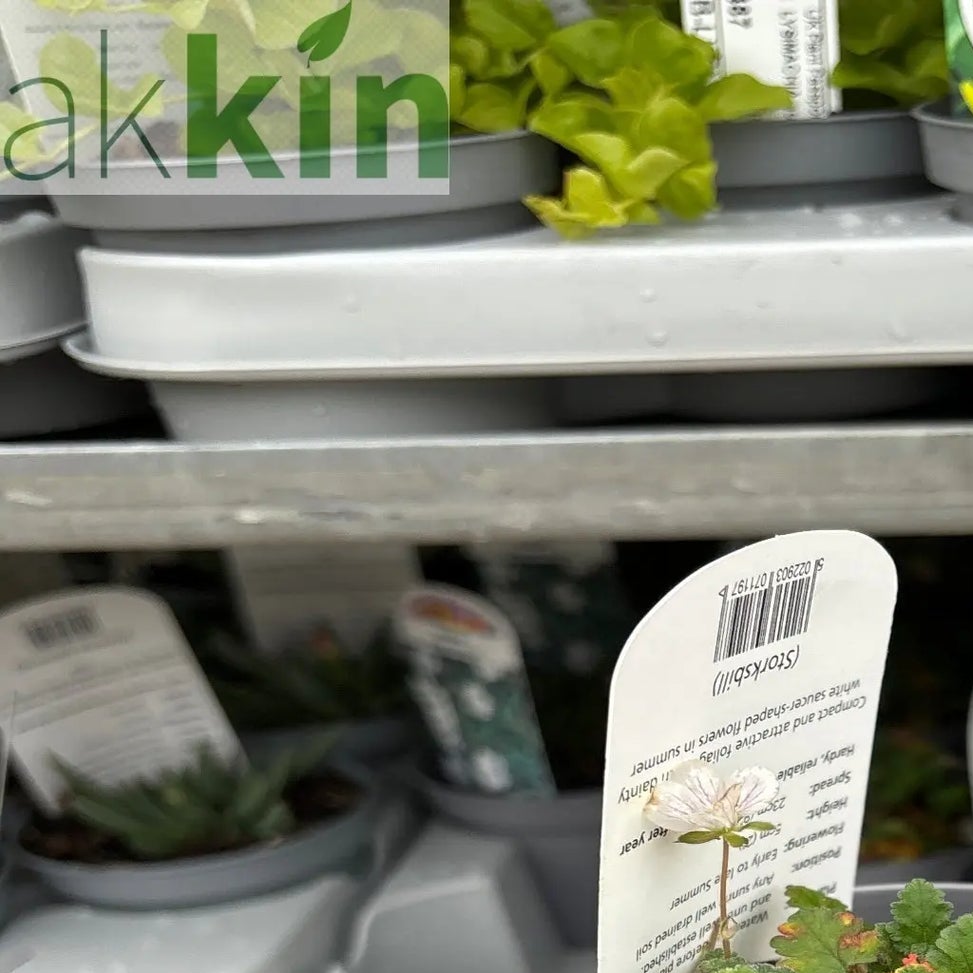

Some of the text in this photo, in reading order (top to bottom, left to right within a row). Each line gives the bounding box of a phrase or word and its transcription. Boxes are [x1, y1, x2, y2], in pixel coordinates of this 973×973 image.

[776, 560, 811, 583] 022903
[731, 572, 767, 597] 071197
[712, 644, 800, 697] (Storksbill)
[828, 679, 861, 698] white
[744, 689, 826, 731] saucer-shaped
[699, 721, 741, 748] flowers
[617, 696, 867, 804] Compact and attractive foliag dainty
[684, 740, 696, 756] in
[630, 746, 681, 777] summer
[776, 744, 856, 781] Hardy, reliable
[808, 770, 852, 797] Spread:
[806, 796, 848, 820] Height:
[619, 831, 646, 856] year
[783, 821, 845, 852] Flowering:
[737, 863, 749, 873] to
[750, 848, 778, 868] Early
[790, 845, 842, 873] Position:
[669, 878, 712, 911] Summer
[752, 873, 775, 891] Any
[695, 901, 717, 923] well
[749, 893, 772, 910] and
[654, 914, 693, 949] drained
[735, 910, 769, 930] Wate
[636, 939, 653, 961] soil
